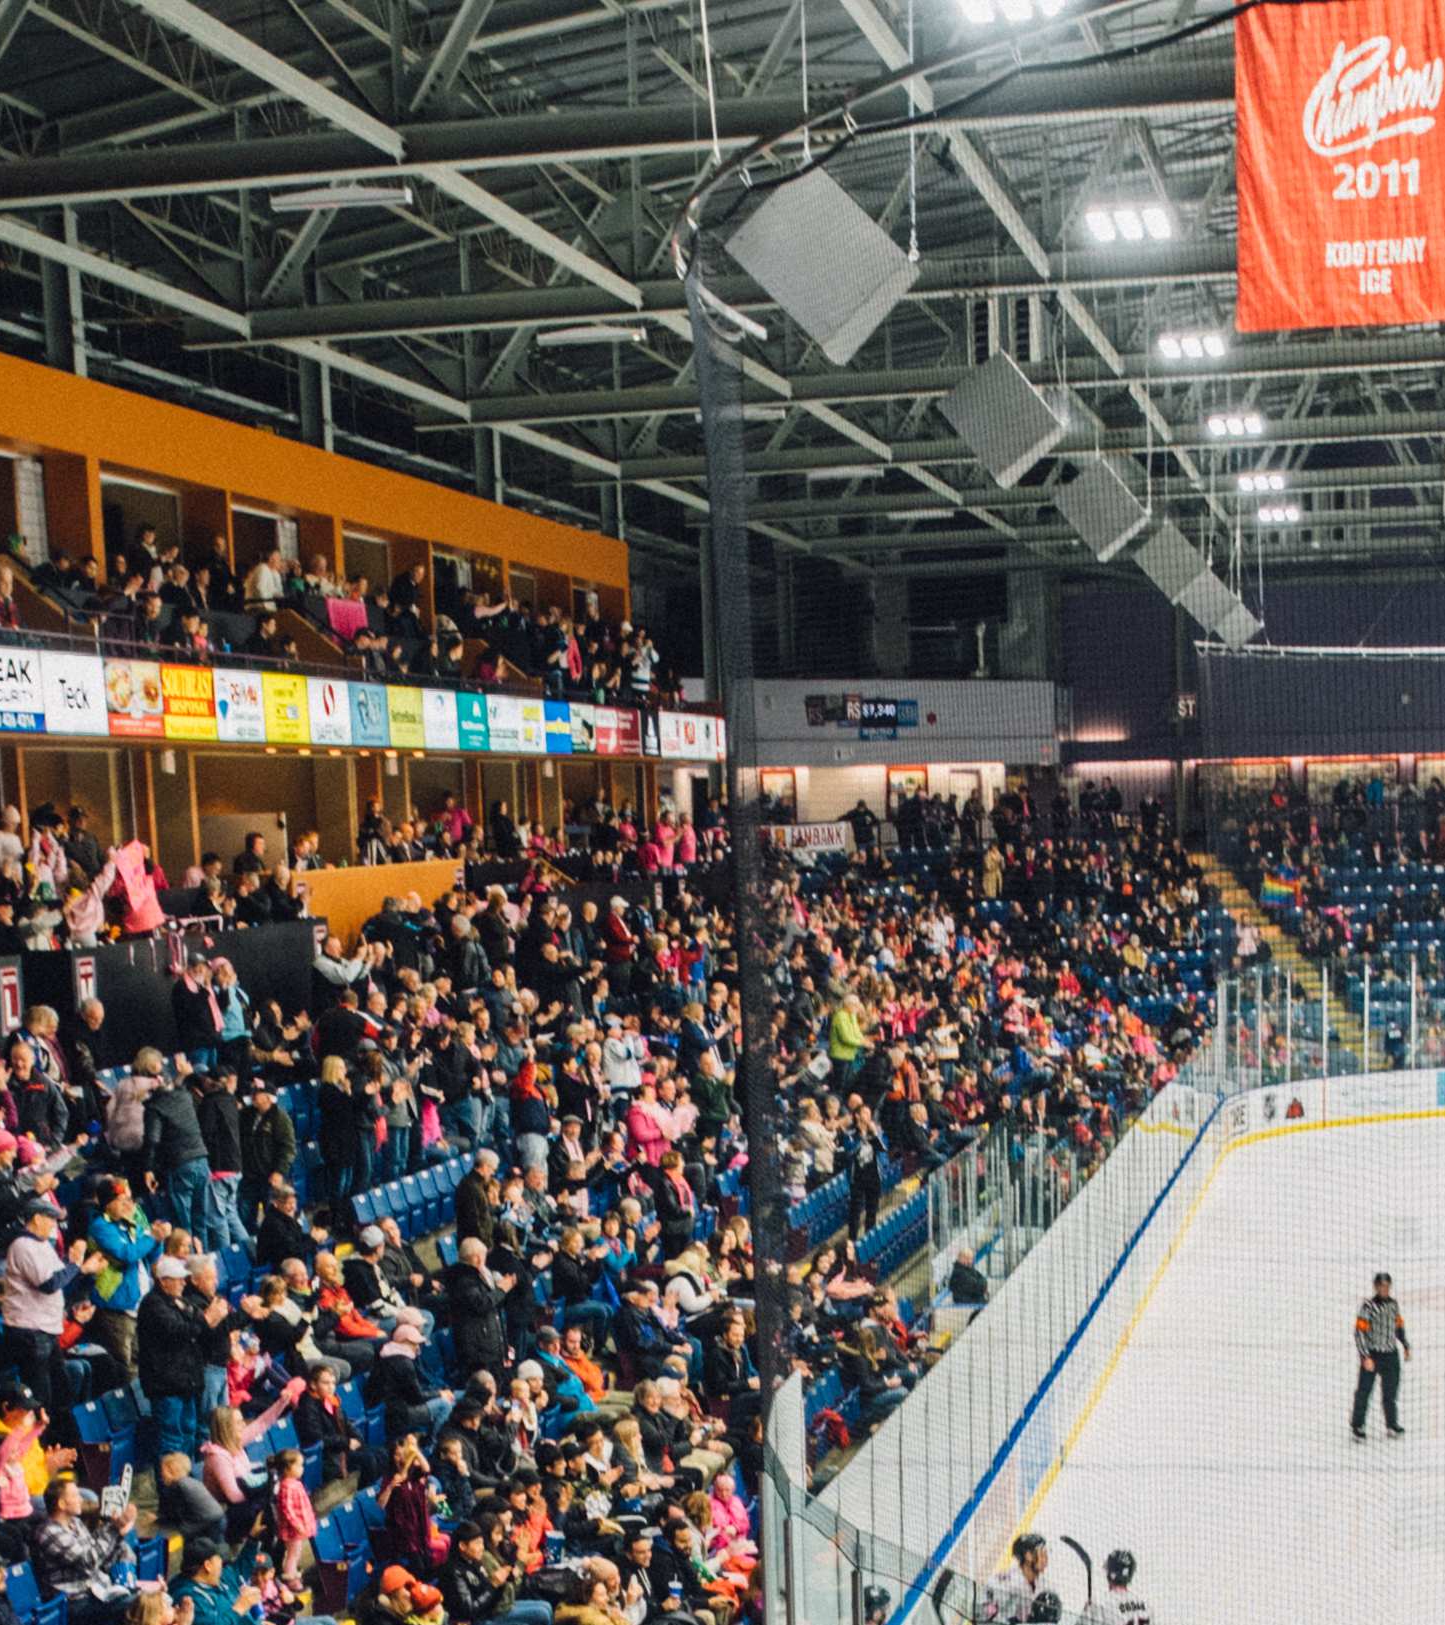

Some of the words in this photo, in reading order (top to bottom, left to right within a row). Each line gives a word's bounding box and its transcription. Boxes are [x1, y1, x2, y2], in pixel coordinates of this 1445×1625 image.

[1304, 35, 1444, 156] Champions
[1332, 158, 1421, 200] 2011
[1325, 235, 1426, 267] KOOTENAY
[1359, 269, 1392, 296] ICE
[58, 677, 92, 710] Teck
[162, 667, 213, 700] SOUTHEAST
[1178, 699, 1195, 717] ST
